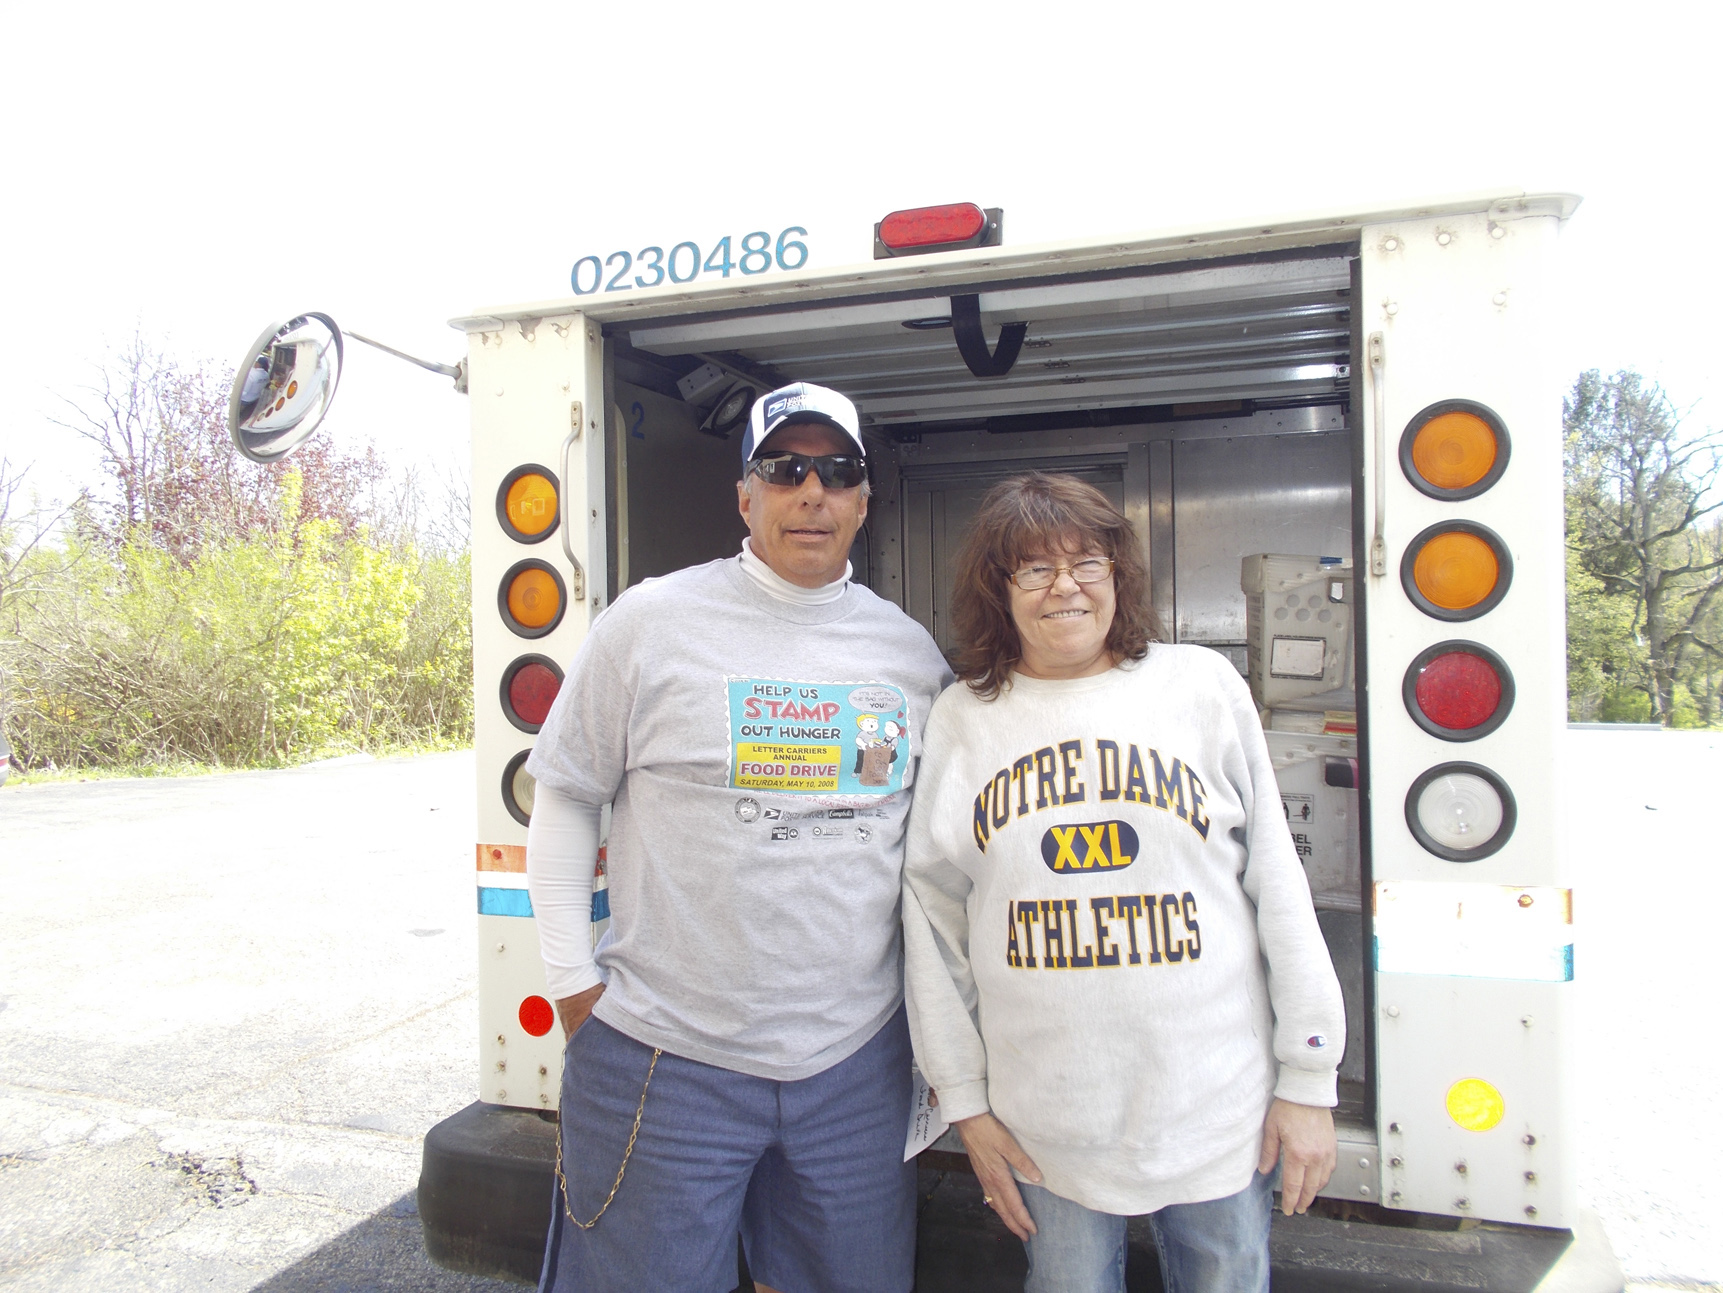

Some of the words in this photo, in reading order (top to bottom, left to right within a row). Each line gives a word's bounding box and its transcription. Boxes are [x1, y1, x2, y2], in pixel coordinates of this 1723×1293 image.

[571, 226, 808, 296] 0230486
[631, 401, 645, 440] 2
[753, 685, 792, 697] HELP
[799, 688, 819, 699] US
[744, 697, 841, 723] STAMP
[741, 725, 774, 737] OUT
[780, 726, 841, 740] HUNGER
[752, 746, 784, 754] LETTER
[786, 747, 828, 755] CARRIERS
[741, 763, 786, 776] FOOD
[790, 765, 837, 777] DRIVE
[740, 779, 784, 788] SATURDAY,
[786, 780, 804, 788] MAY
[818, 780, 835, 788] 2008
[973, 738, 1087, 856] NOTRE
[1096, 738, 1211, 843] DAME
[1050, 822, 1132, 870] XXL
[1006, 891, 1202, 969] ATHLETICS
